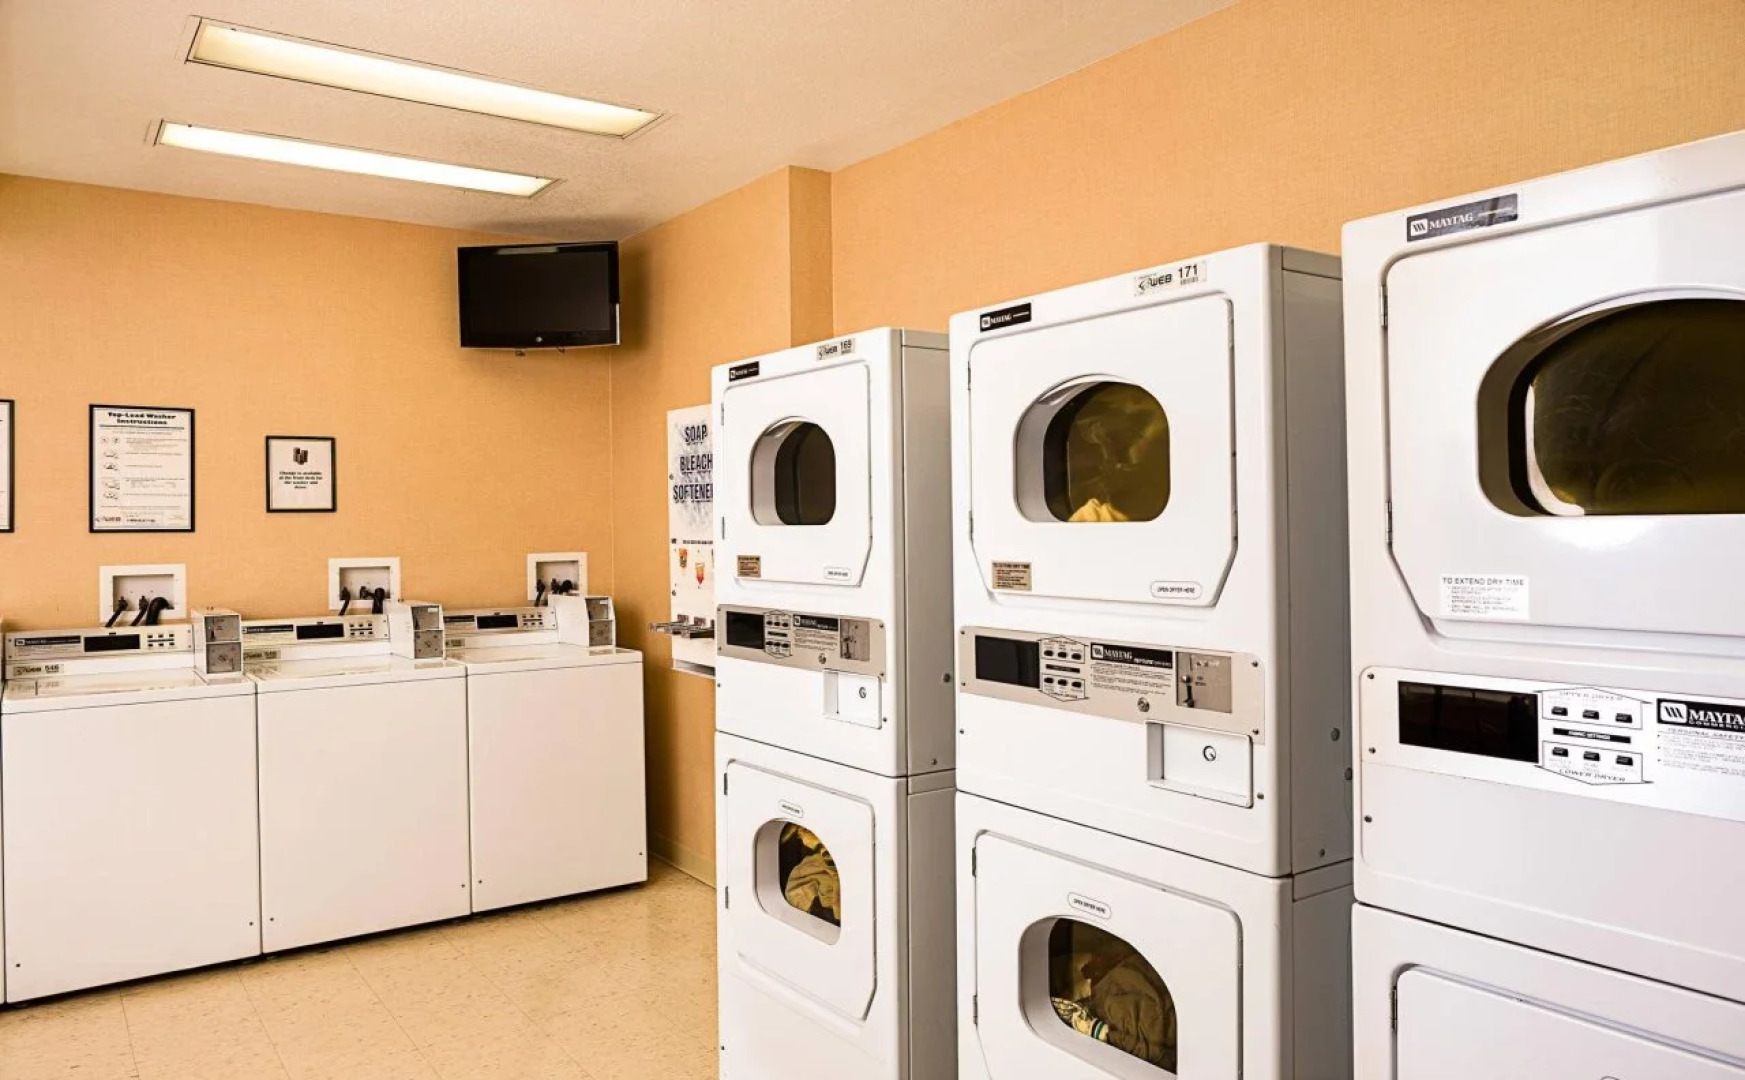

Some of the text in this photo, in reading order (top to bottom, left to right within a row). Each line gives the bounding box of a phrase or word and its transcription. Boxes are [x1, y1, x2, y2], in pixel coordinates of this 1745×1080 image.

[1429, 213, 1473, 229] MAYTAG
[1149, 274, 1172, 287] WEB
[1178, 264, 1198, 279] 171
[685, 424, 708, 442] SOAP
[680, 453, 713, 471] BLEACH
[1442, 577, 1453, 585] TO
[1454, 577, 1485, 586] EXTEND
[1487, 578, 1503, 586] DRY
[1688, 709, 1745, 725] MAYTA
